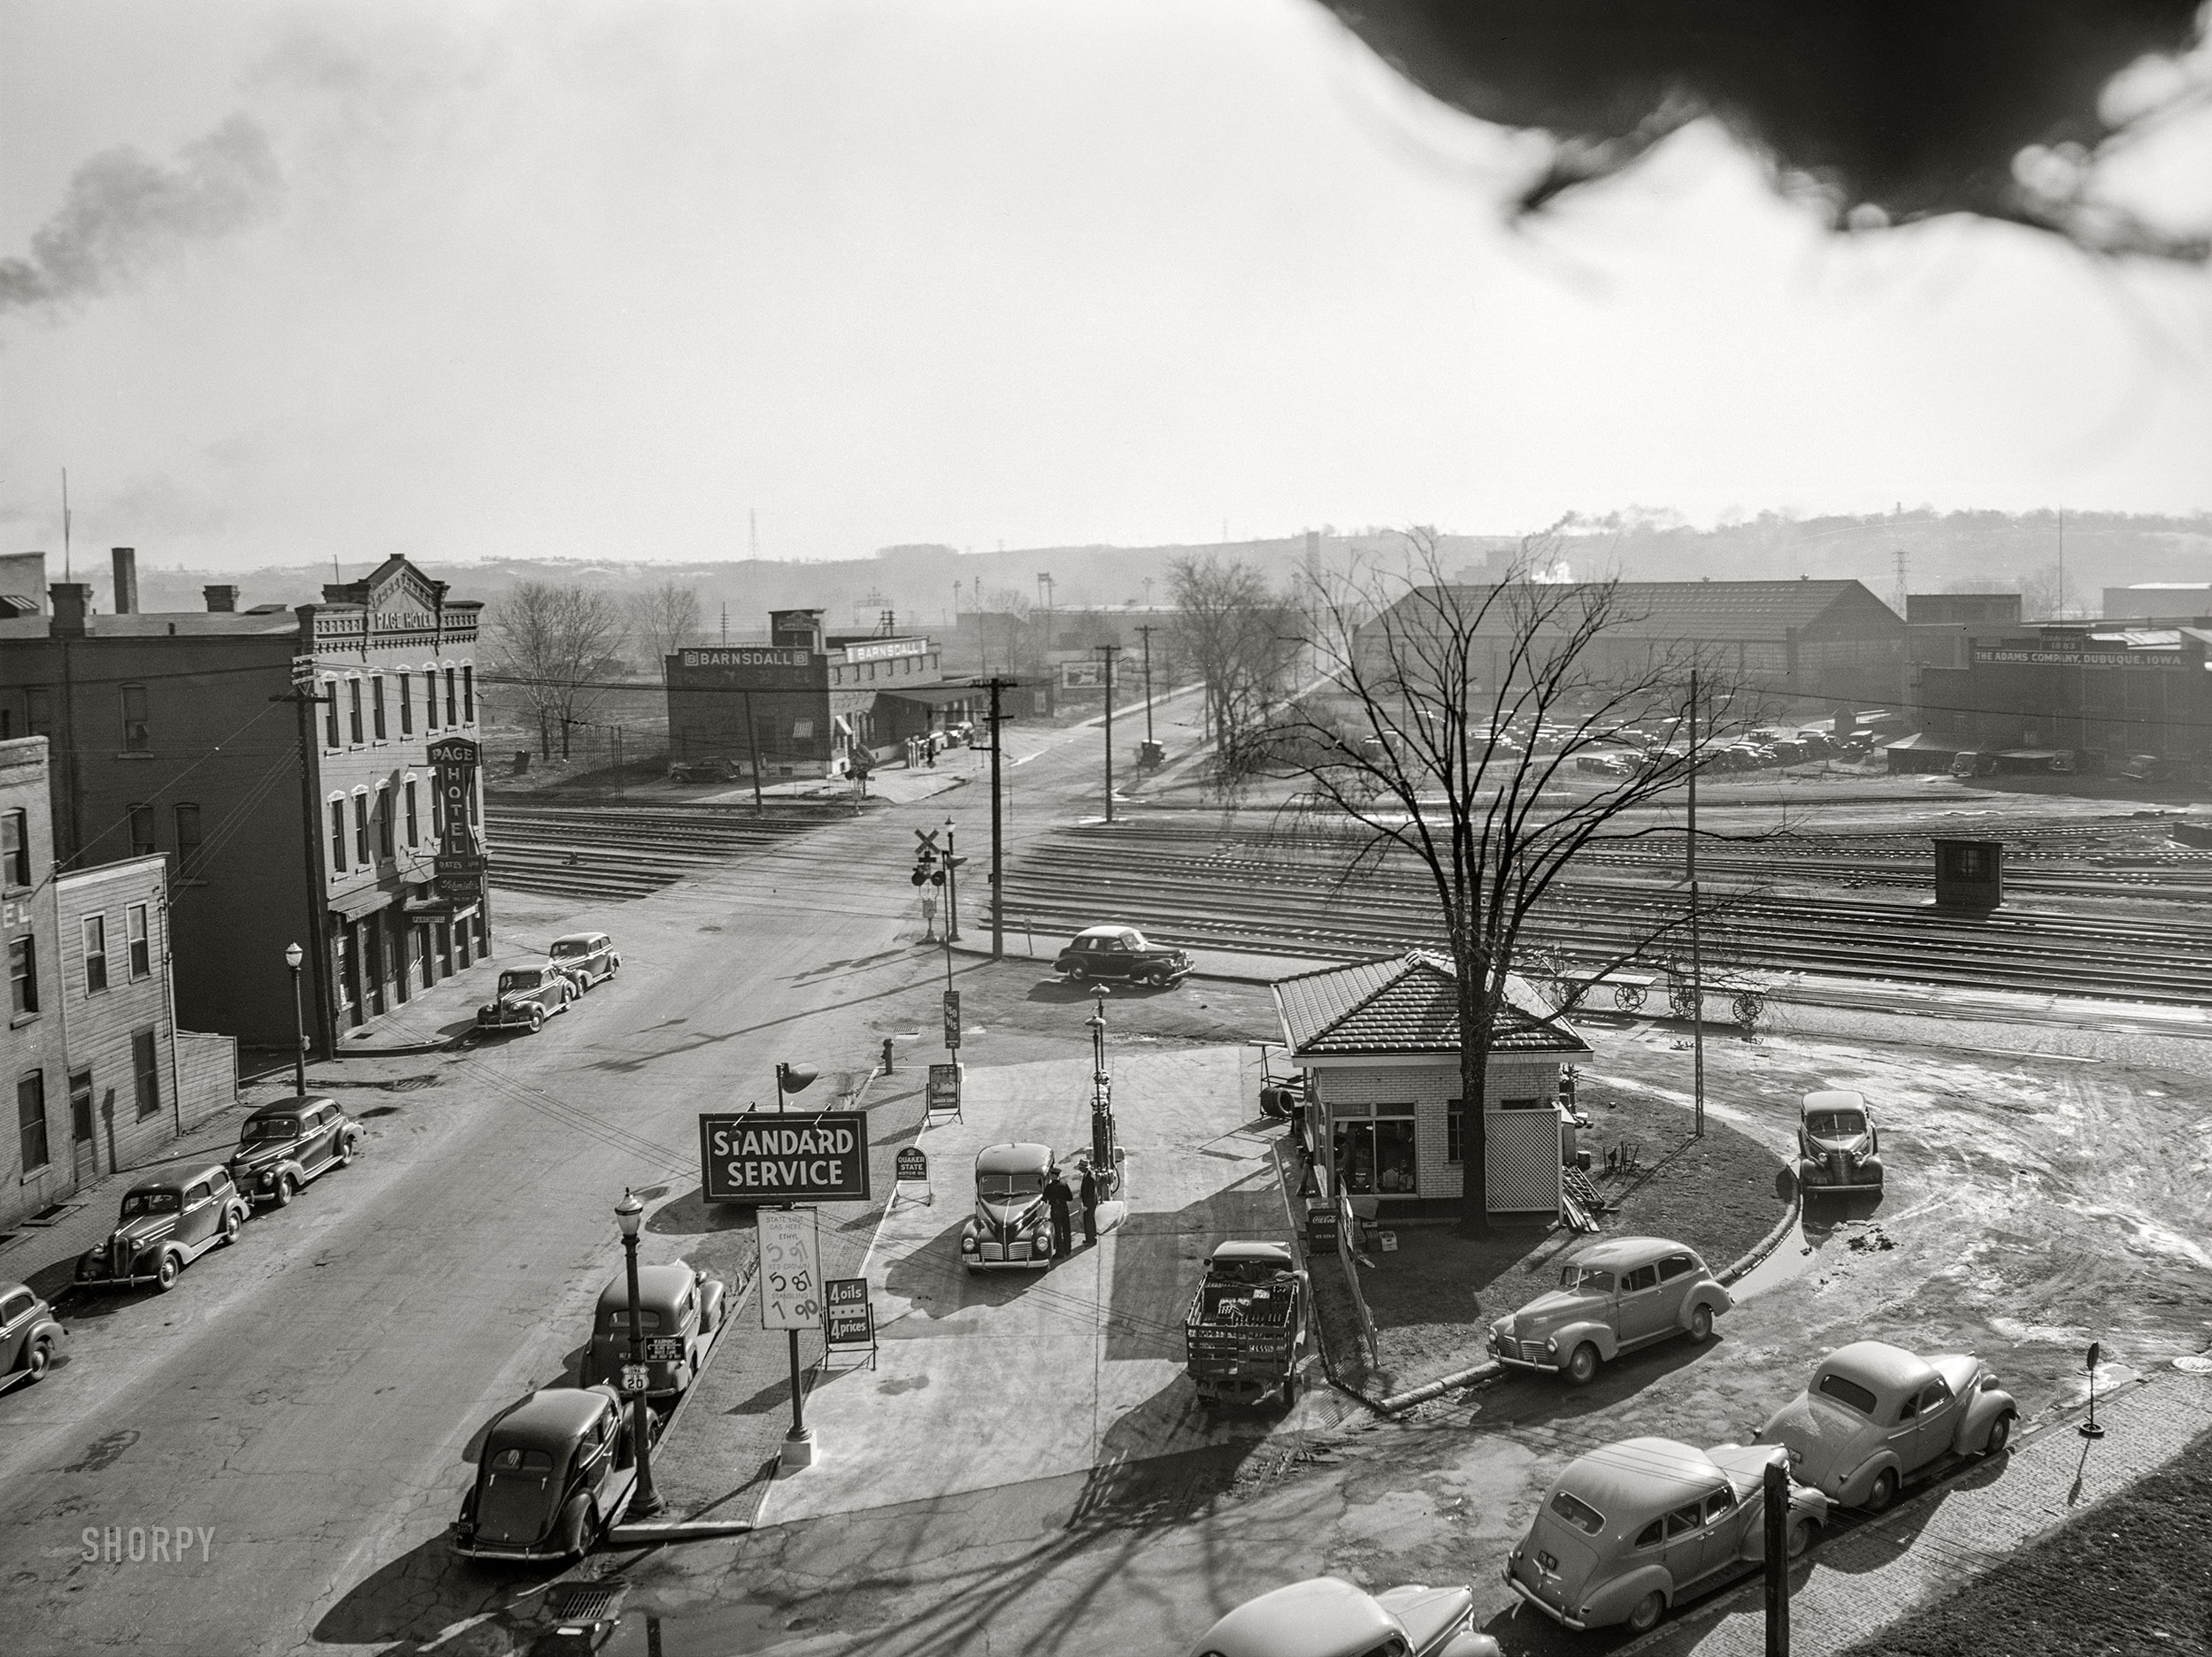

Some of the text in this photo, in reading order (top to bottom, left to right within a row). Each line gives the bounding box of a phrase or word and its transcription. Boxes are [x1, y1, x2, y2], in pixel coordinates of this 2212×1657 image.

[375, 611, 435, 629] PAGE HOTEL
[701, 652, 792, 664] BARNSDALL
[857, 642, 919, 660] BARNSDALL
[1976, 651, 1993, 661] THE
[1994, 652, 2029, 662] ADAMS
[2031, 653, 2081, 664] COMPANY,
[432, 747, 473, 761] PAGE
[448, 767, 465, 855] HOTEL
[714, 1129, 854, 1156] STANDARD
[727, 1160, 844, 1186] SERVICE
[1312, 1215, 1337, 1224] Coca-Cola
[765, 1239, 809, 1262] 5 97
[769, 1270, 812, 1292] 5 87
[830, 1284, 863, 1304] 4 oils
[831, 1319, 866, 1339] 4 prices
[627, 1379, 643, 1389] 20
